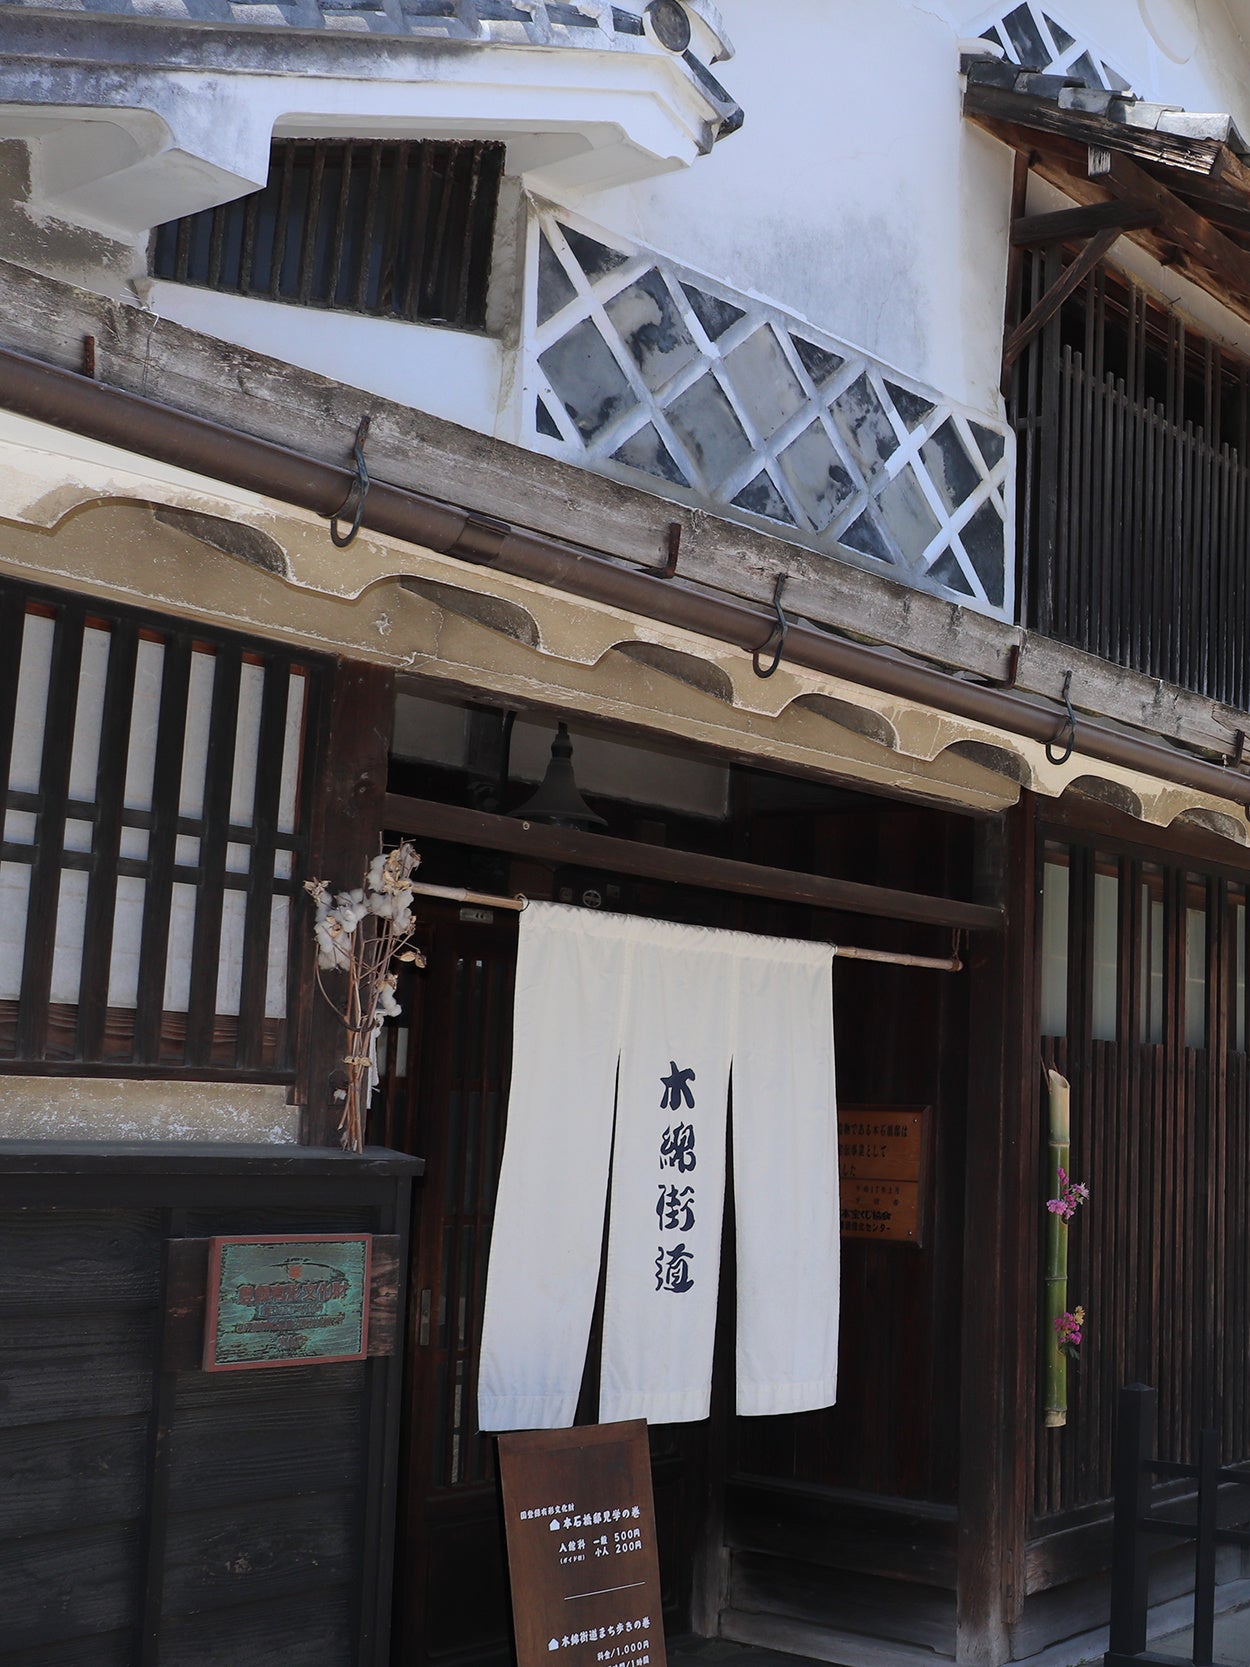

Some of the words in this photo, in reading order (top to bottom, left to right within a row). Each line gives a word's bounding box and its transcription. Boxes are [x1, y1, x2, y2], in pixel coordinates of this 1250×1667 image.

[655, 1060, 697, 1294] 木綿街道
[614, 1528, 641, 1543] 500円
[594, 1546, 610, 1558] 小人
[615, 1540, 642, 1554] 200円
[561, 1616, 651, 1648] 木綿街道まち歩きの巻
